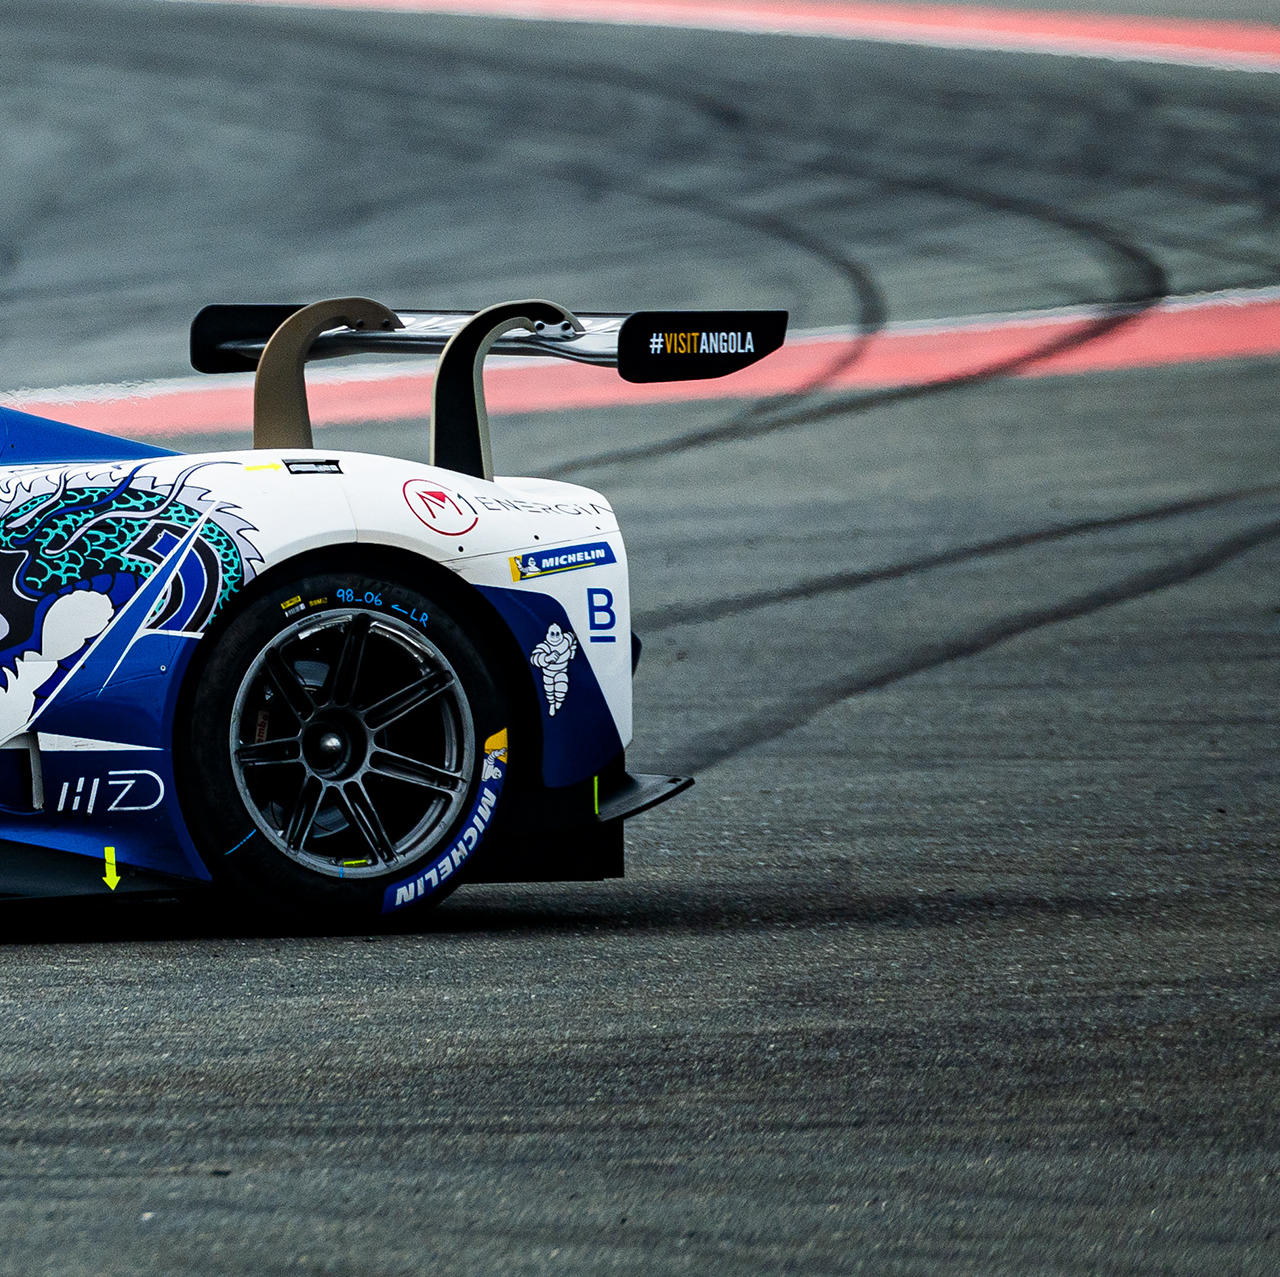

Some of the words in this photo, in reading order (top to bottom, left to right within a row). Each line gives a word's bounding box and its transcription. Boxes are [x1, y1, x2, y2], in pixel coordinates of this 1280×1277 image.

[649, 332, 755, 354] #VISITANGOLA
[541, 548, 605, 569] MICHELIN
[395, 787, 497, 906] MICHELIN
